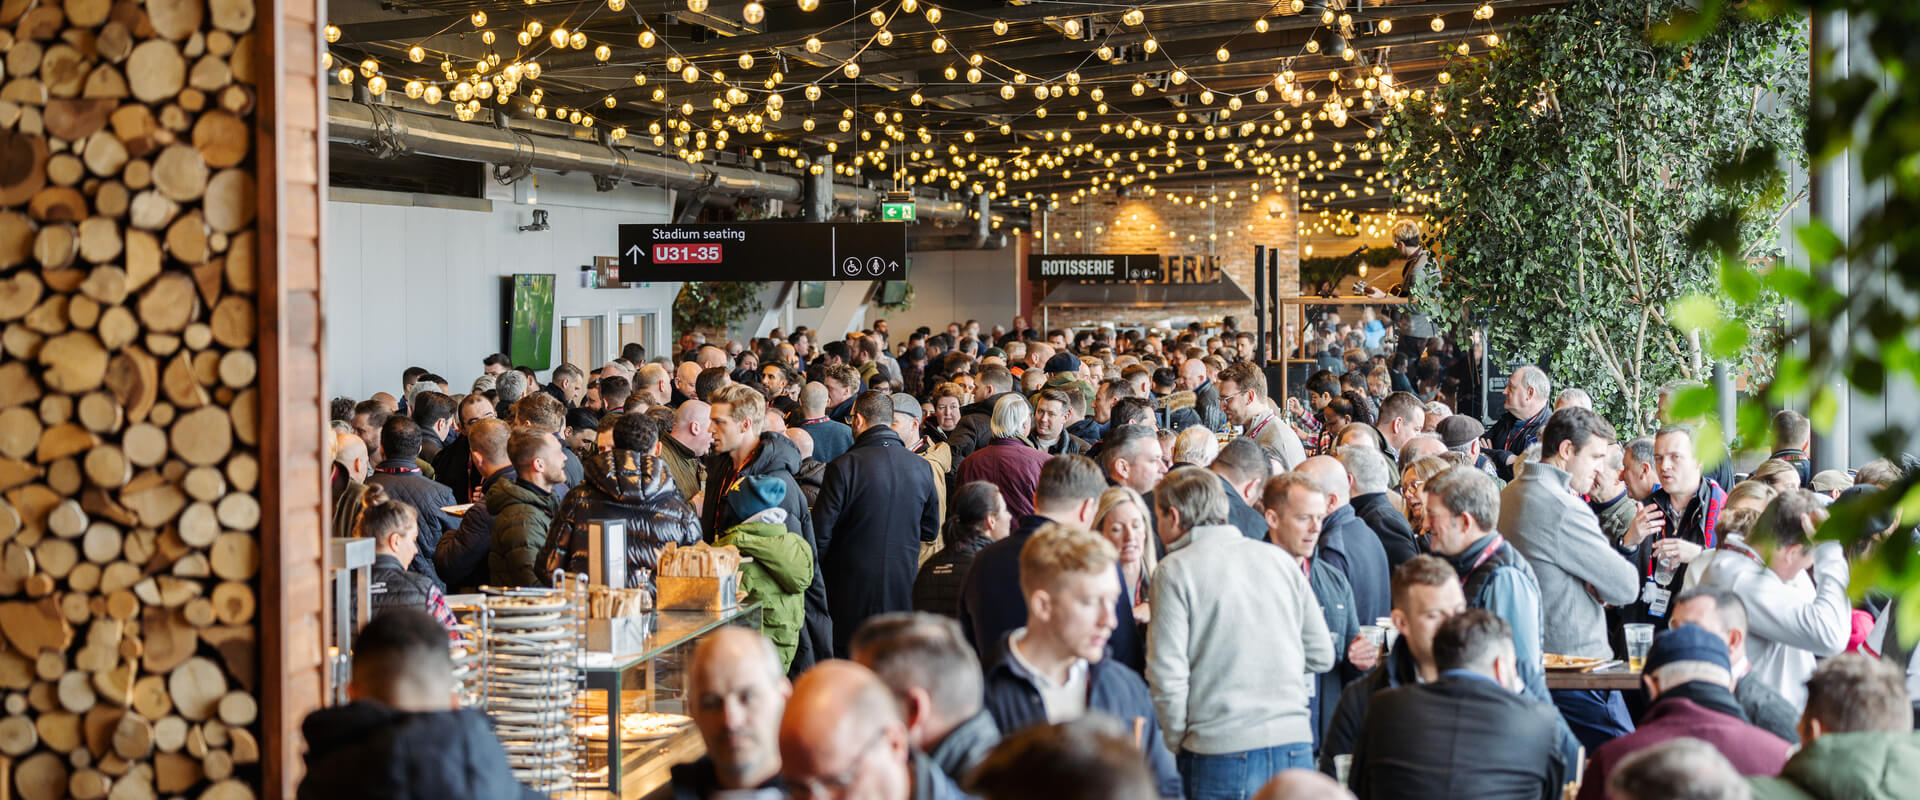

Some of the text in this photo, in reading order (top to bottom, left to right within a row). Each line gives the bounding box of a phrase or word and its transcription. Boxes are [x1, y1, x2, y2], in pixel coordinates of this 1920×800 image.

[652, 228, 745, 241] Stadium seating
[656, 246, 720, 261] U31-35
[1041, 259, 1115, 276] ROTISSERIE
